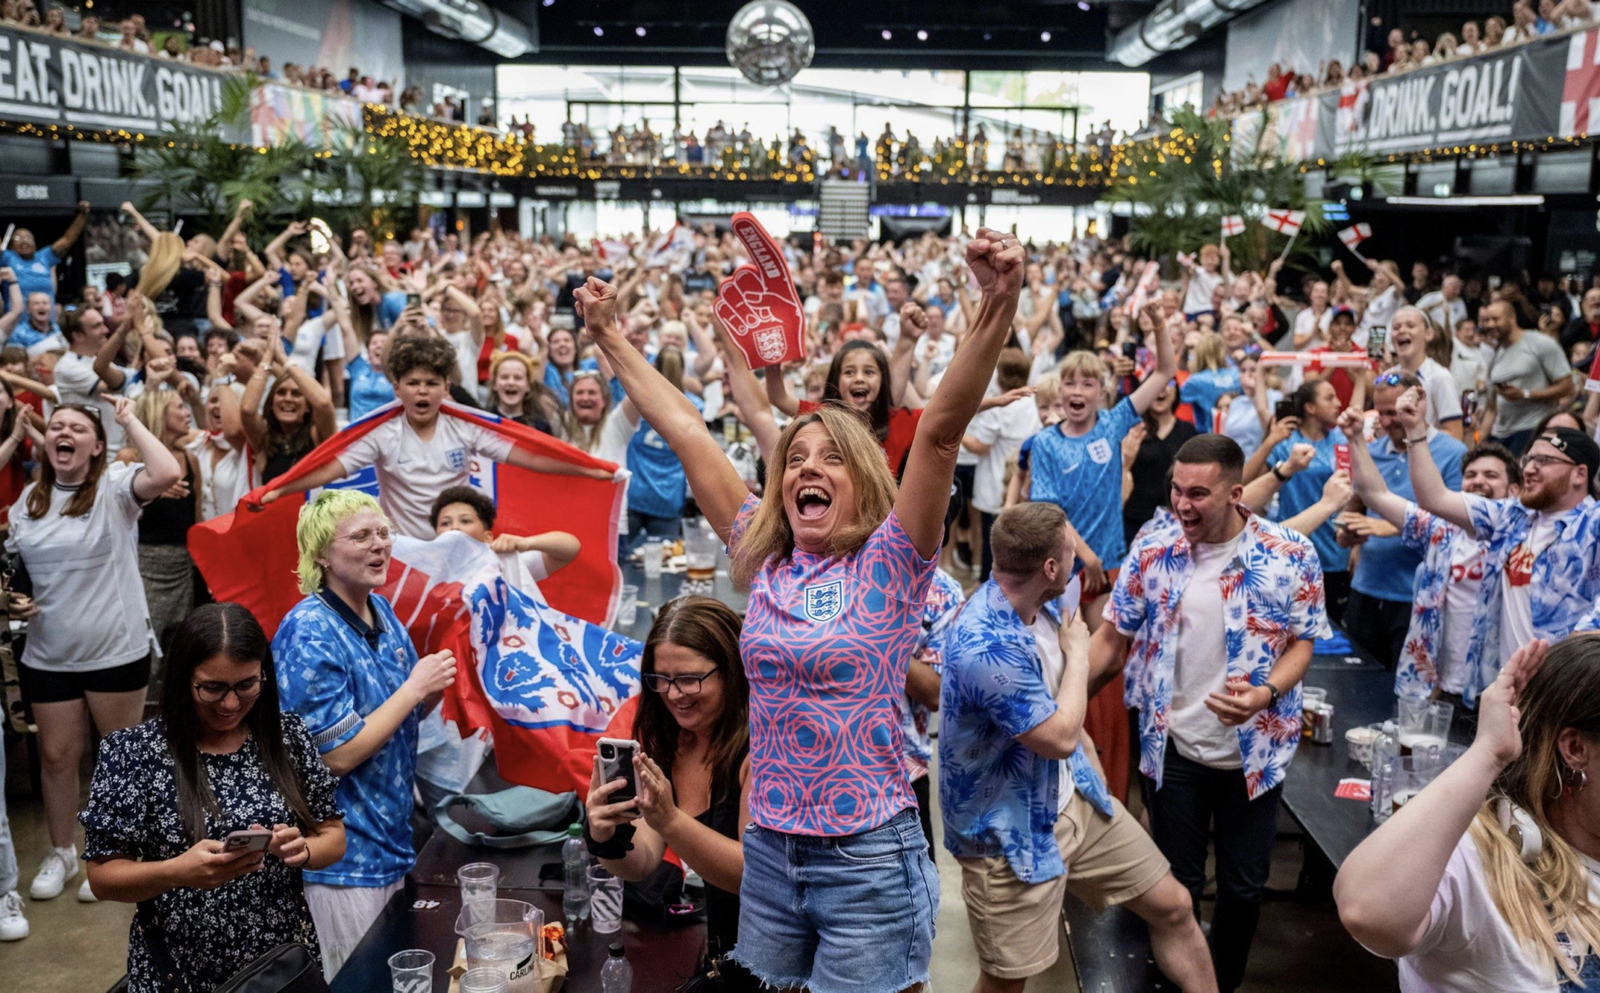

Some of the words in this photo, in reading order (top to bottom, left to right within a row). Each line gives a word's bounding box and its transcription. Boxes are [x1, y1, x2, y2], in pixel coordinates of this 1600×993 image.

[61, 48, 156, 118] DRINK.
[1369, 75, 1436, 138] DRINK.
[1439, 55, 1521, 129] GOAL!
[740, 226, 781, 279] ENGLAND
[412, 899, 441, 909] 48
